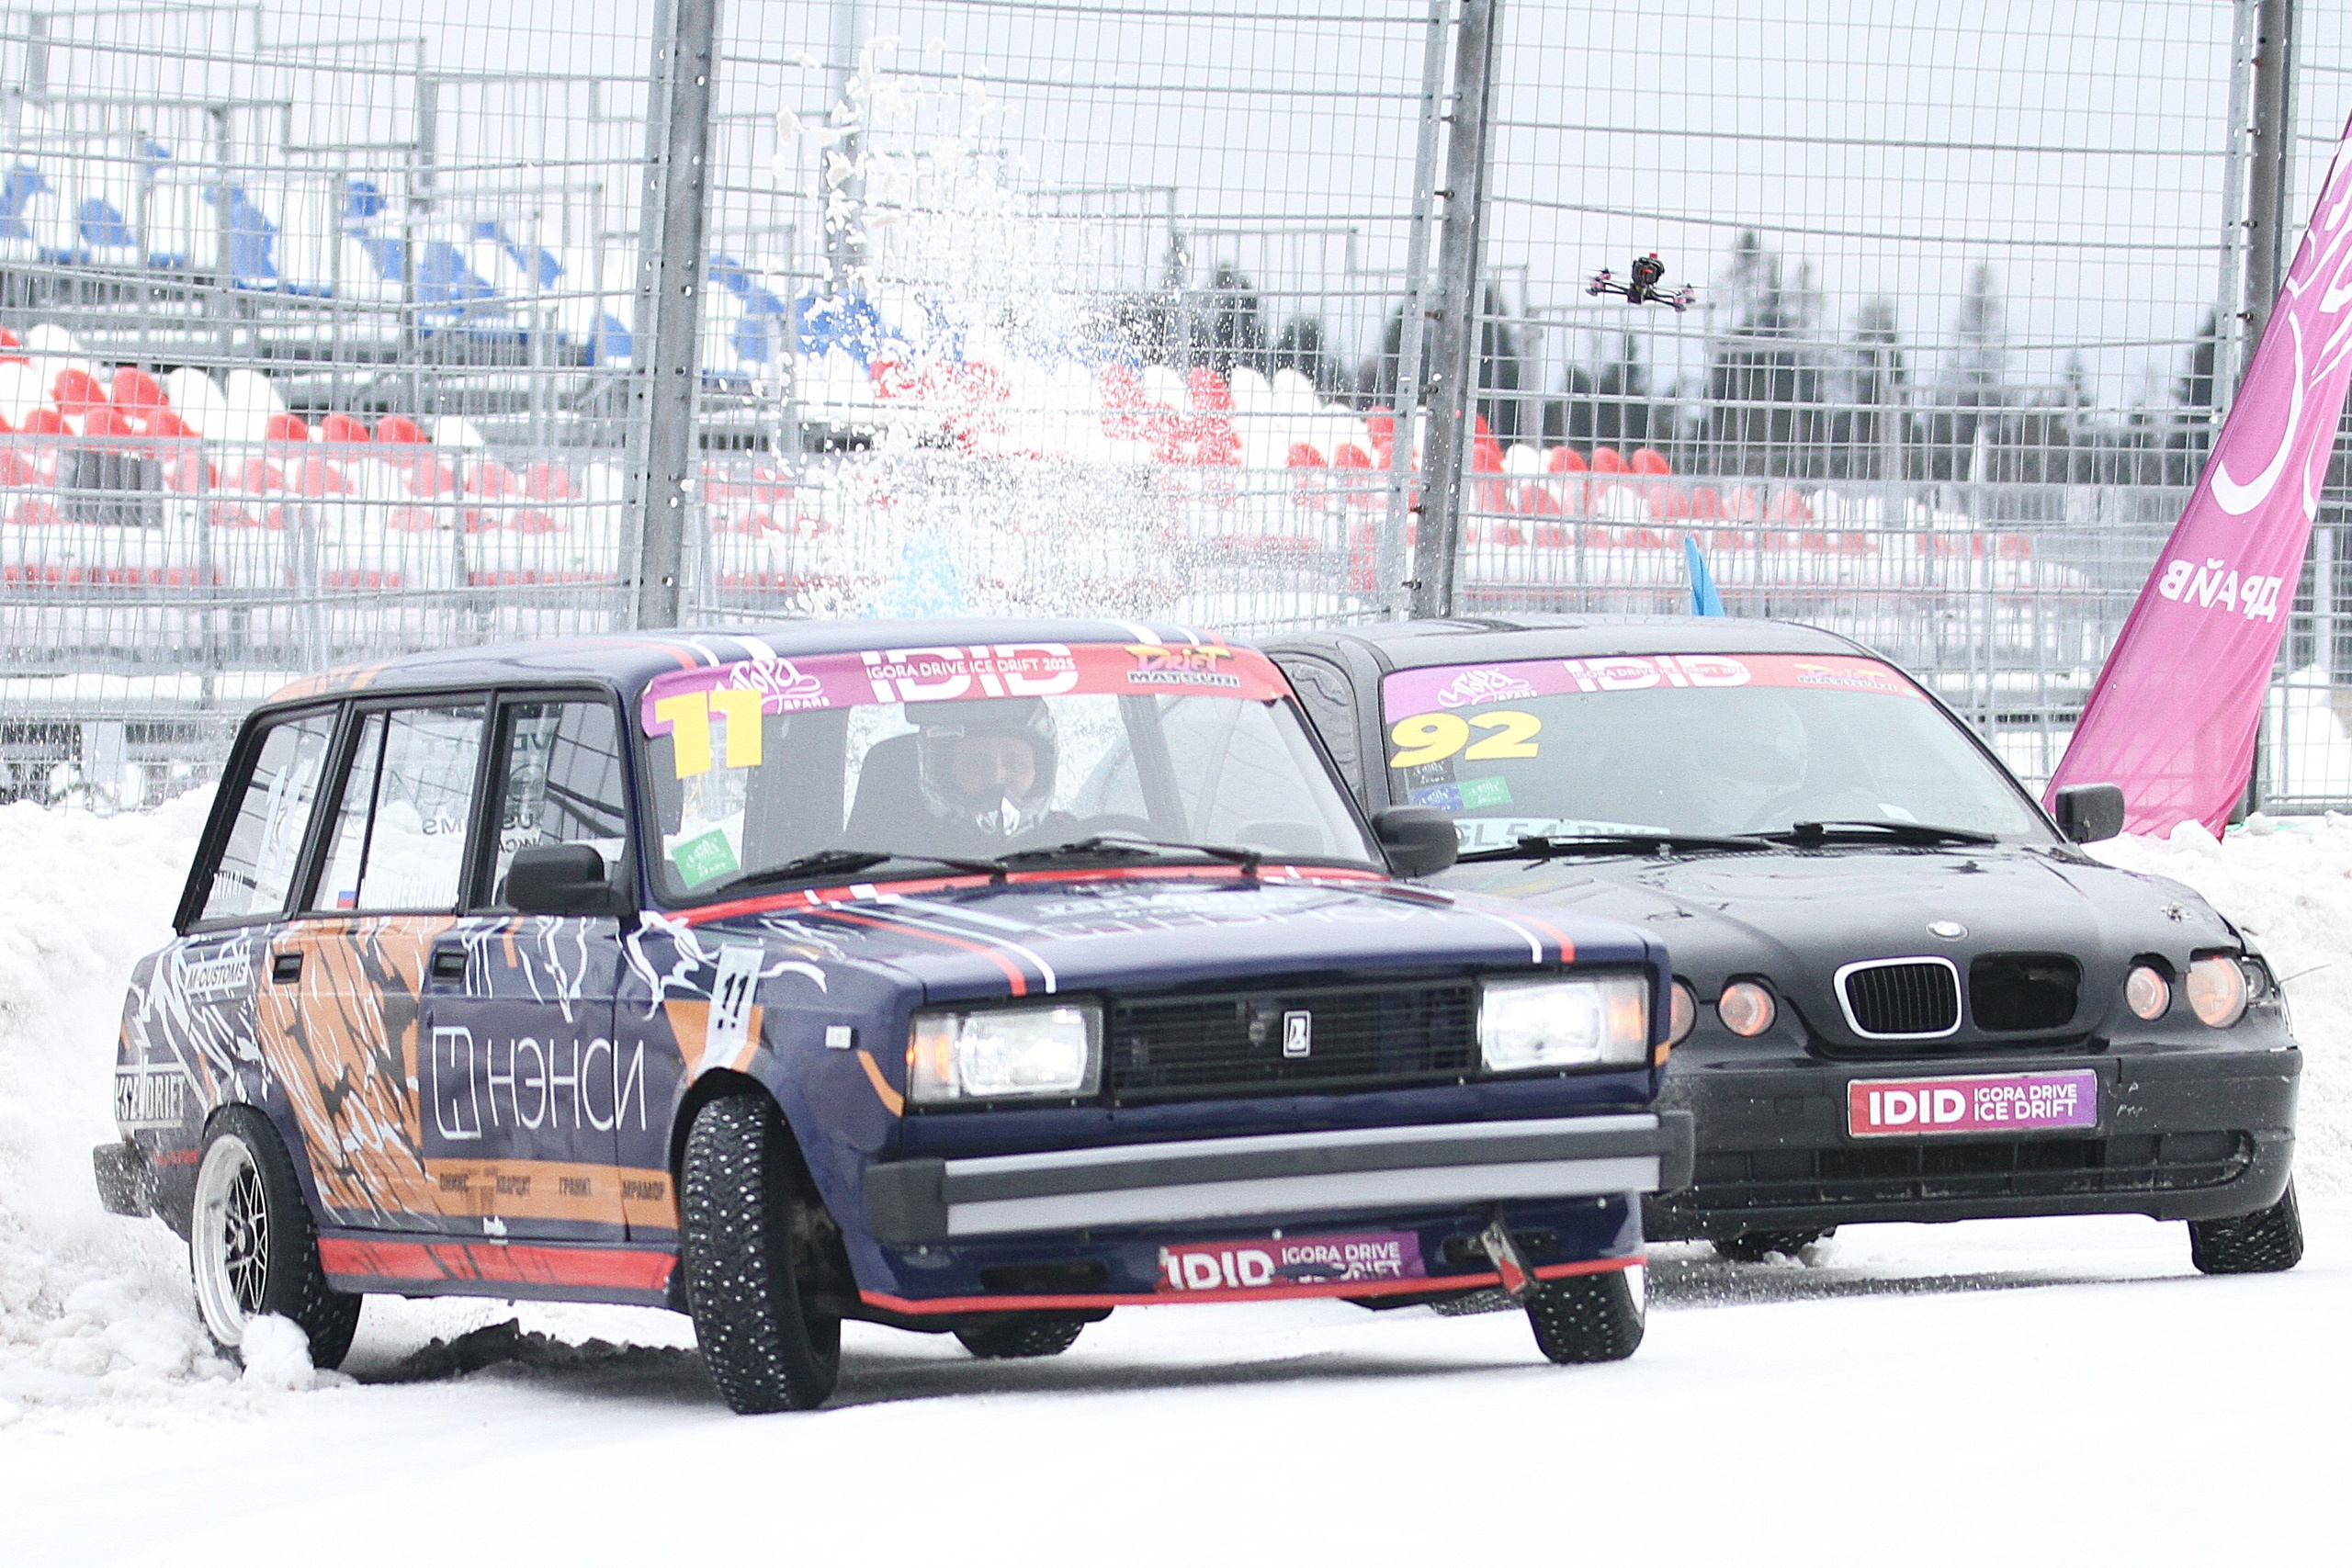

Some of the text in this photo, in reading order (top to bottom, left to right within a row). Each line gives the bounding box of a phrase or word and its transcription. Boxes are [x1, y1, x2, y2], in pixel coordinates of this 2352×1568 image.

[860, 643, 1079, 704] IDID
[866, 662, 919, 680] IGORA
[920, 660, 966, 677] DRIVE
[969, 659, 995, 673] ICE
[997, 658, 1039, 672] DRIFT
[1563, 655, 1751, 693] IDID
[655, 688, 762, 779] 11
[1390, 711, 1542, 768] 92
[145, 1075, 186, 1120] DRIFT
[487, 1035, 648, 1132] НЭНСИ
[1974, 1083, 2077, 1102] IGORA DRIVE
[1869, 1089, 1966, 1125] IDID
[1973, 1099, 2077, 1122] ICE DRIFT
[1167, 1249, 1275, 1290] IDID
[1282, 1241, 1400, 1266] IGORA DRIVE
